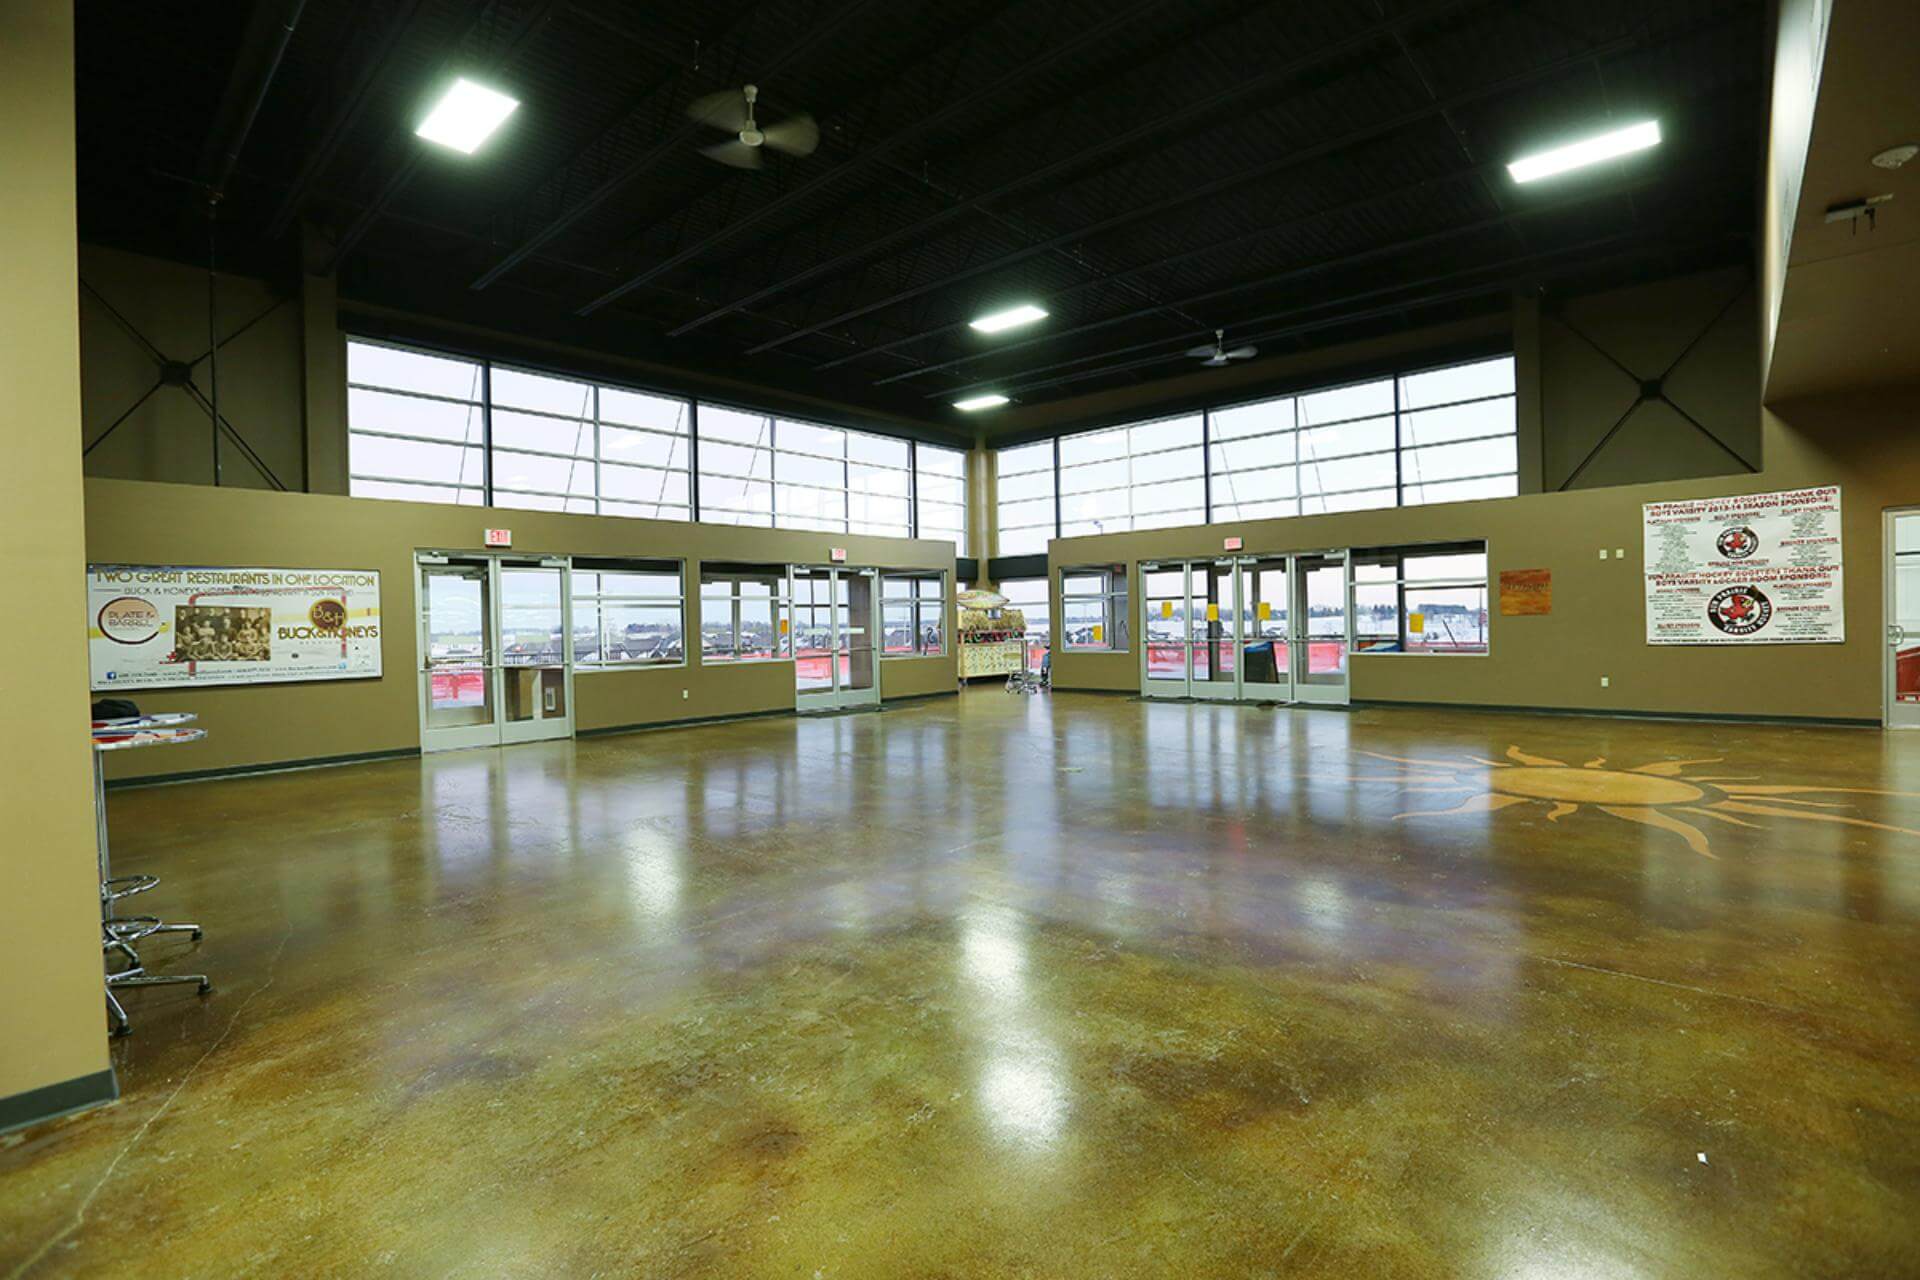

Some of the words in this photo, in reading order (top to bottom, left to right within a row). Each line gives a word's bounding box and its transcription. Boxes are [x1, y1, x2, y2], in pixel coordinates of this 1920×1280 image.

[1781, 491, 1814, 499] THANK
[1815, 488, 1838, 496] OUR
[1672, 507, 1706, 516] VARSITY
[1707, 504, 1741, 512] 2013-14
[1743, 501, 1779, 510] SEASON
[96, 568, 133, 583] TWO
[135, 571, 183, 584] GREAT
[186, 571, 270, 585] RESTAURANTS
[271, 574, 283, 585] IN
[285, 574, 313, 586] ONE
[313, 574, 375, 587] LOCATION
[1698, 570, 1734, 578] HOCKEY
[1783, 566, 1817, 574] THANK
[1678, 578, 1712, 586] VARSITY
[1713, 577, 1748, 585] LOCKER
[1750, 574, 1778, 583] ROOM
[124, 587, 153, 595] BUCK
[108, 611, 144, 619] PLATE
